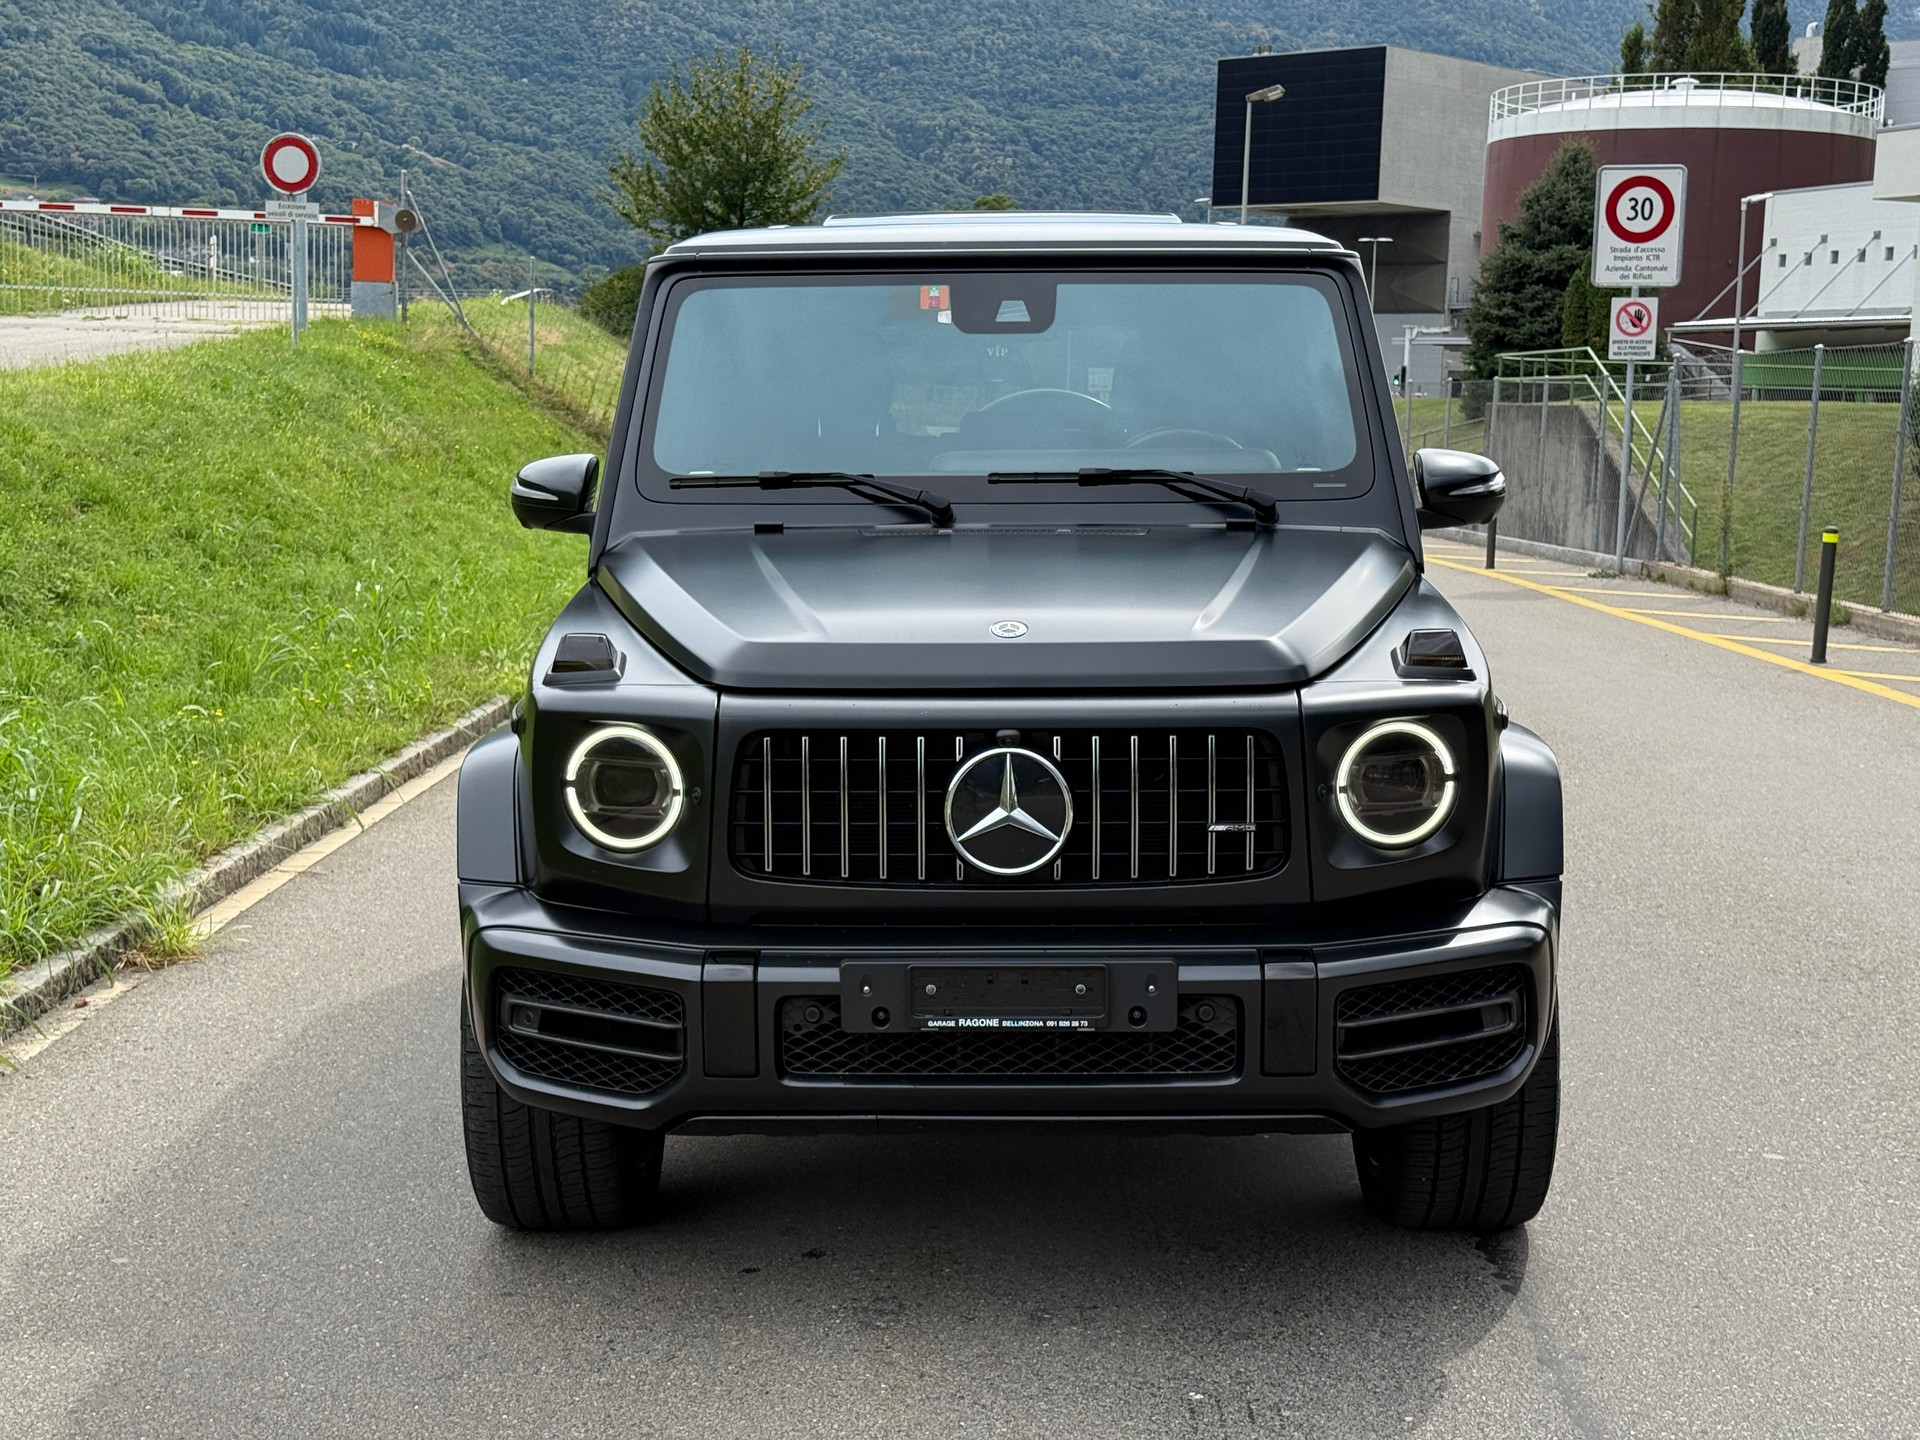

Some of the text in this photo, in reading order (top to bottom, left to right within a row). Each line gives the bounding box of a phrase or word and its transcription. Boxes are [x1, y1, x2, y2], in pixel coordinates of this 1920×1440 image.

[1626, 197, 1654, 221] 30
[1613, 254, 1643, 262] Impianto
[959, 1018, 1000, 1027] RAGONE
